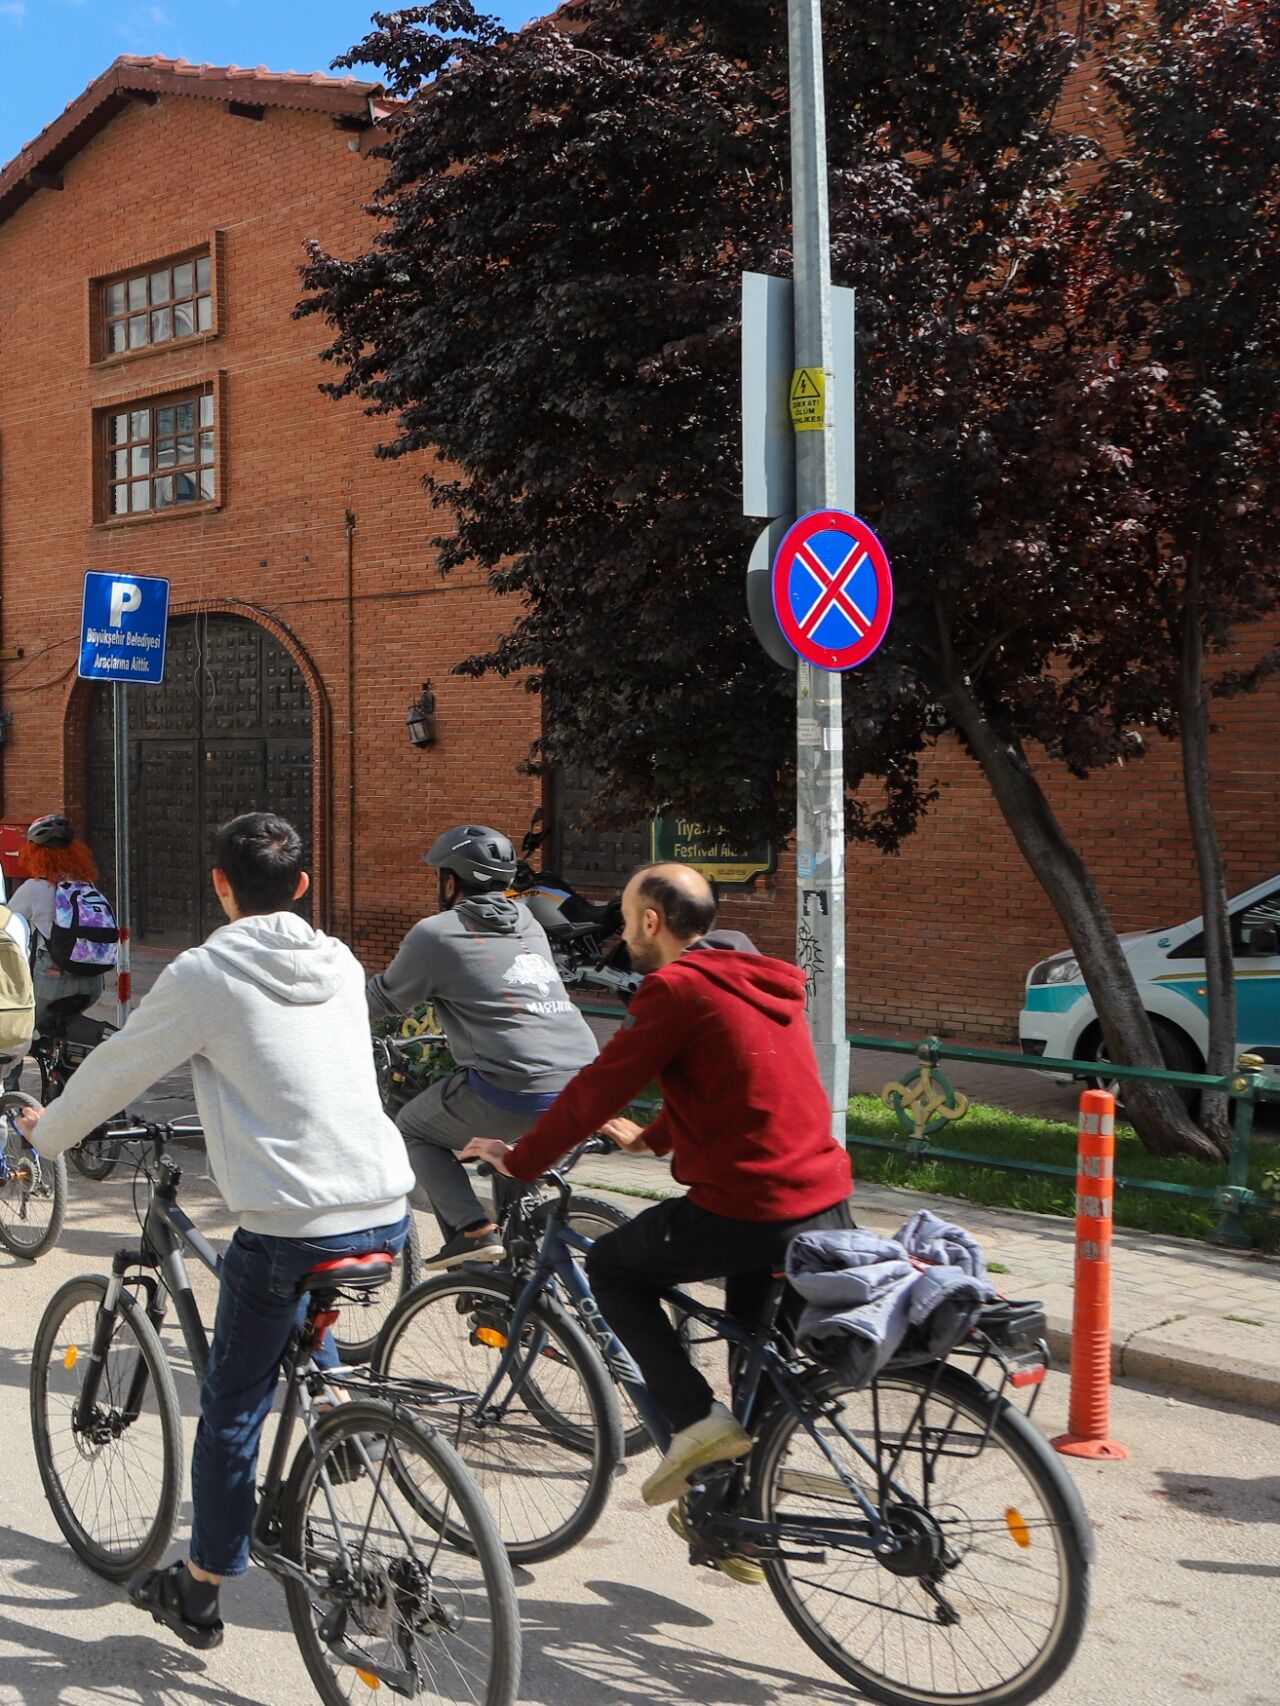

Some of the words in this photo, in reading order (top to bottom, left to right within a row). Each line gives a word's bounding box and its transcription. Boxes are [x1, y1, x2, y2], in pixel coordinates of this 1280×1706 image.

[109, 582, 142, 628] P
[86, 627, 126, 648] Büyükşehir
[126, 631, 160, 651] Belediyesi
[94, 653, 130, 672] Araçlarına
[131, 656, 150, 672] Aittir.
